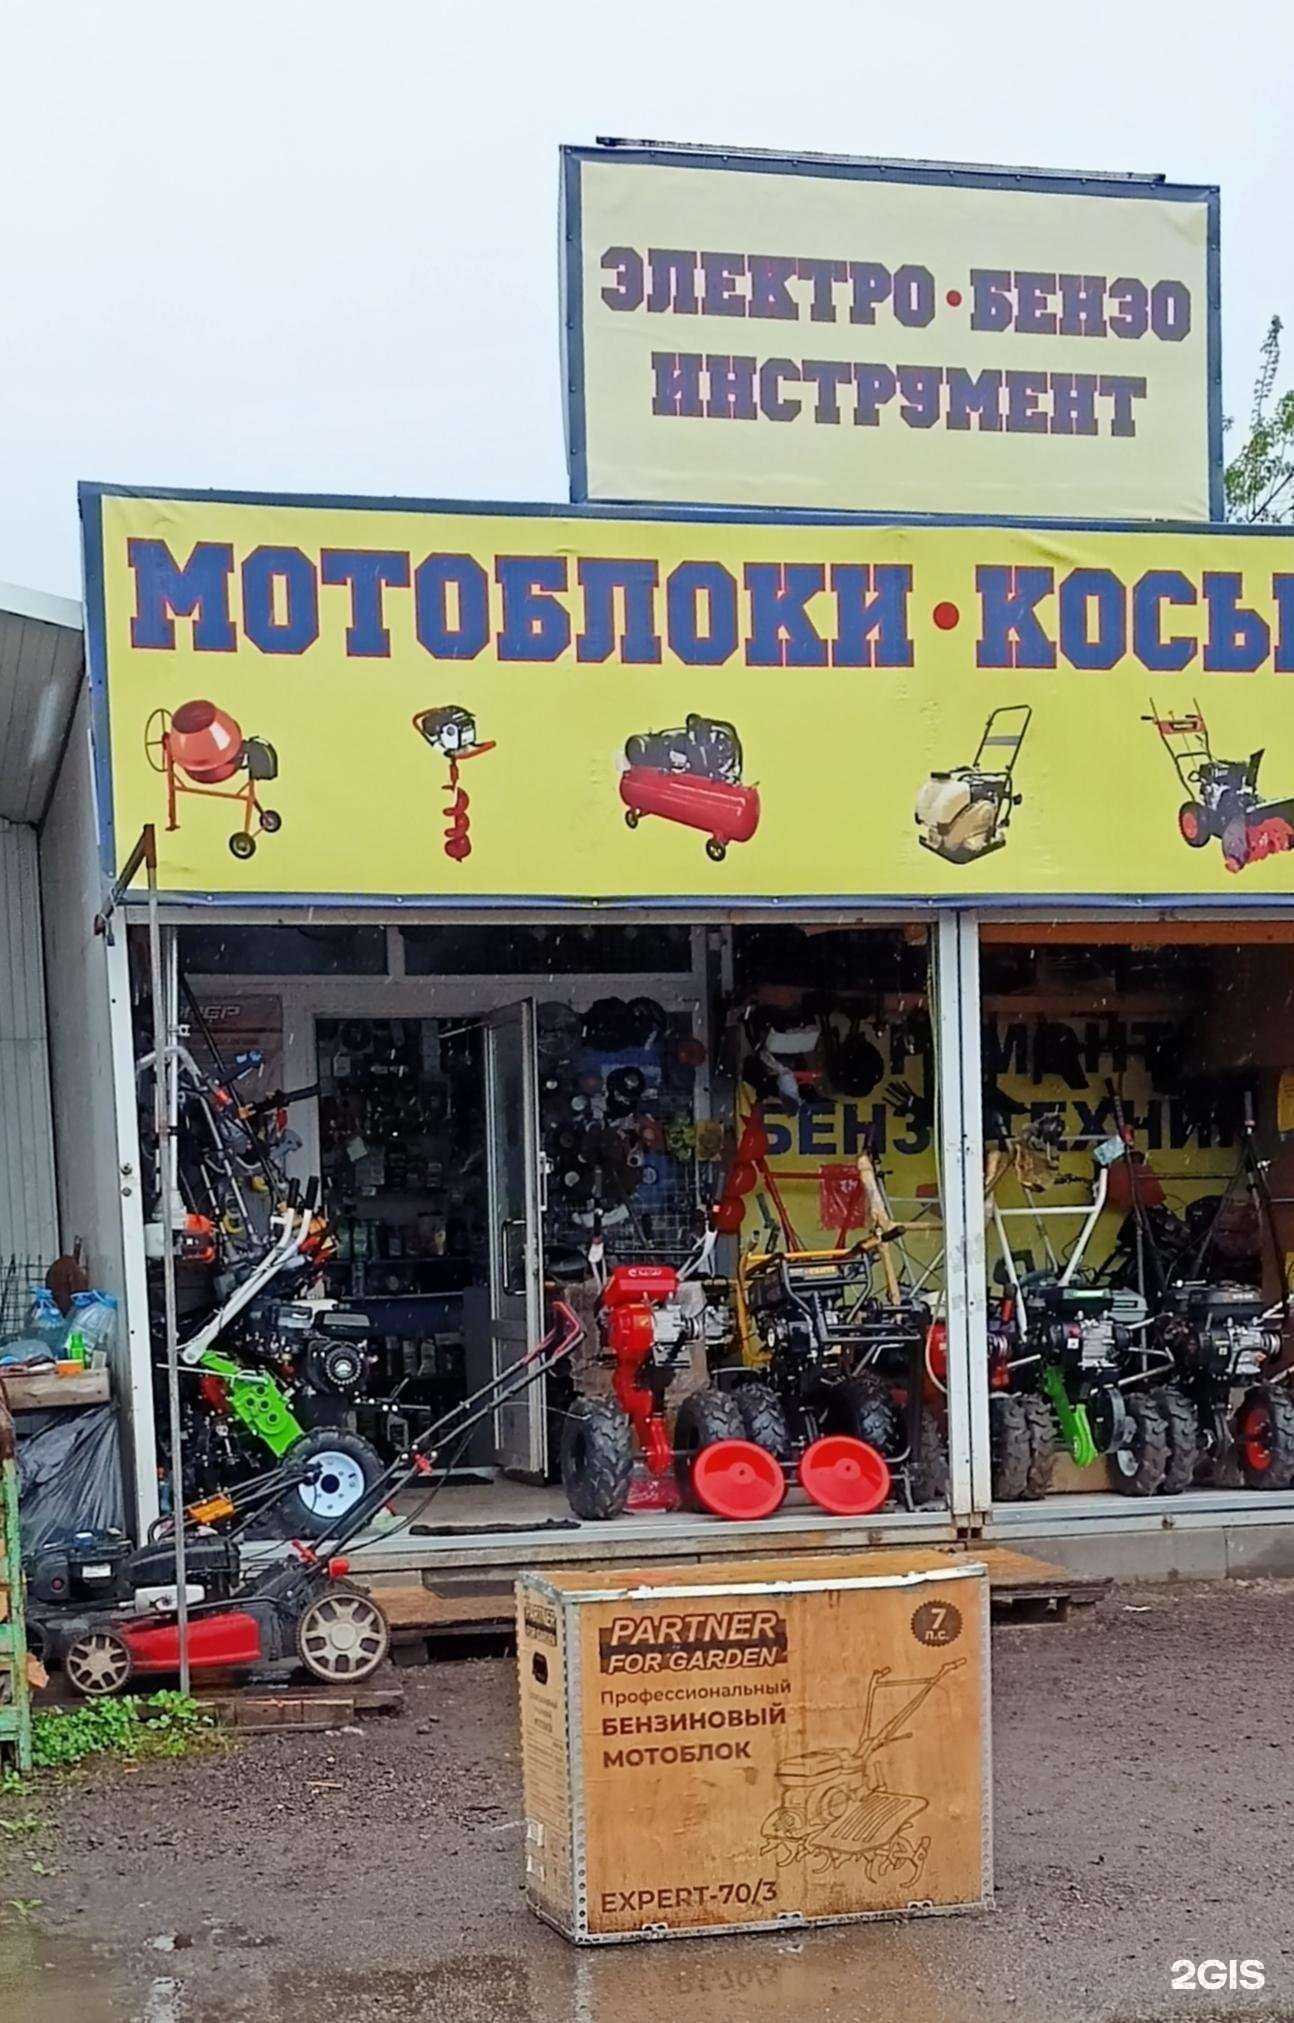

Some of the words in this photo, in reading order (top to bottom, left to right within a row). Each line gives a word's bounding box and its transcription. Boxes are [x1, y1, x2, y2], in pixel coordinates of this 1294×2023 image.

[600, 246, 935, 328] ЭЛЕКТРО
[970, 268, 1191, 342] БЕНЗО
[651, 350, 1147, 438] ИНСТРУМЕНТ
[127, 537, 914, 667] МОТОБЛОКИ
[609, 1610, 779, 1647] PARTNER
[931, 1608, 946, 1629] 7
[607, 1651, 663, 1675] FOR
[667, 1645, 779, 1671] GARDEN
[601, 1680, 791, 1707] Профессиональный
[602, 1702, 786, 1736] БЕНЗИНОВЫЙ
[603, 1741, 751, 1768] МОТОБЛОК
[601, 1878, 778, 1913] EXPERT-70/3
